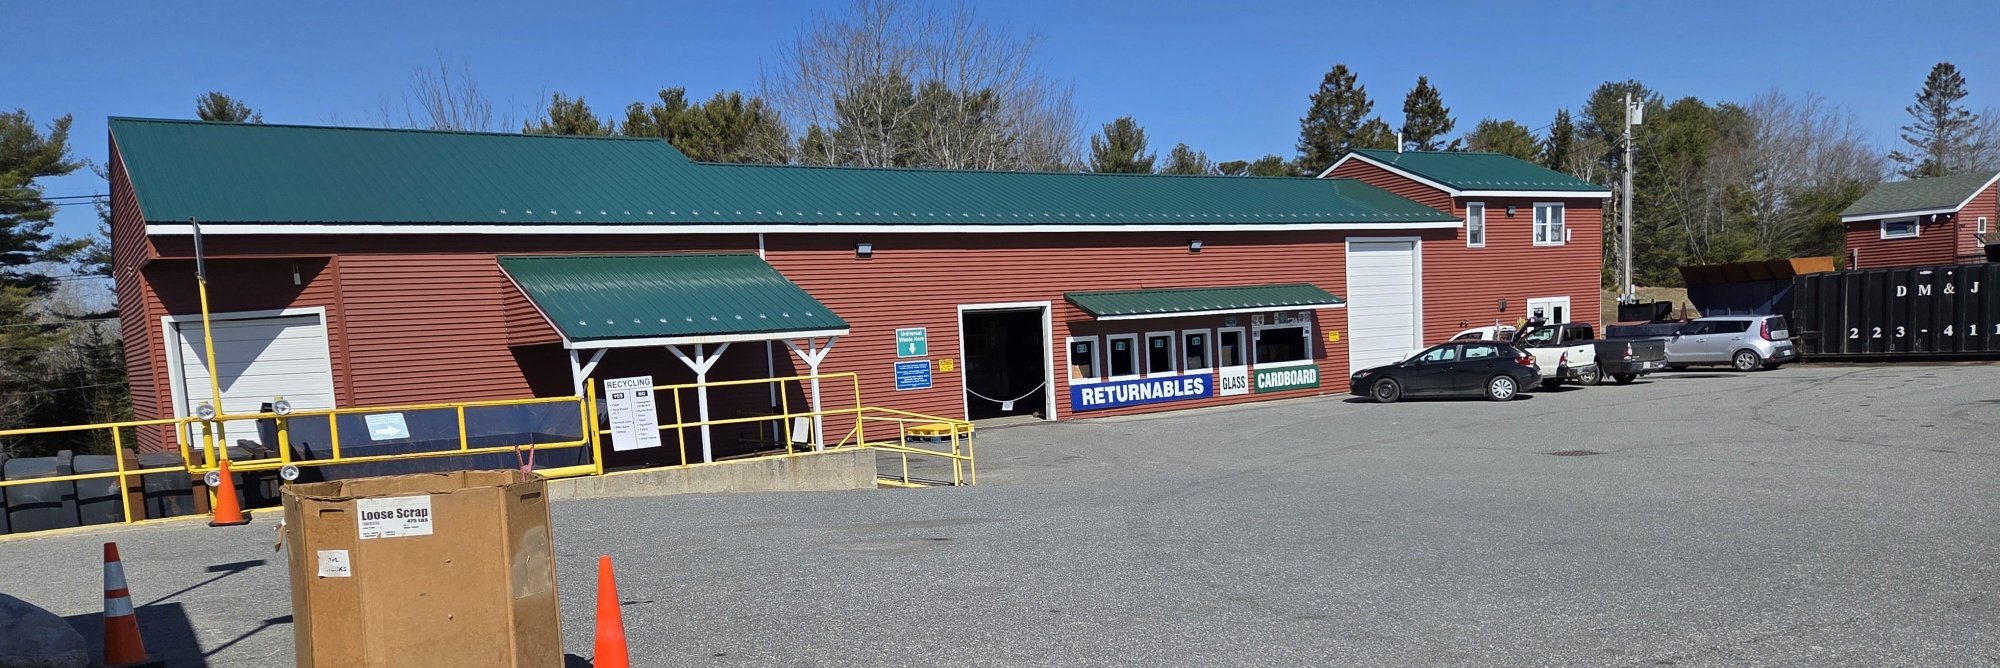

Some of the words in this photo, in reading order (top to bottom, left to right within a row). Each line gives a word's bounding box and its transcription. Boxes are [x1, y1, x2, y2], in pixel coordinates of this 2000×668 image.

[606, 378, 651, 388] RECYCLING
[1222, 375, 1246, 390] GLASS
[1257, 368, 1317, 389] CARDBOARD
[1081, 377, 1204, 406] RETURNABLES
[361, 510, 394, 521] Loose
[396, 508, 428, 518] Scrap
